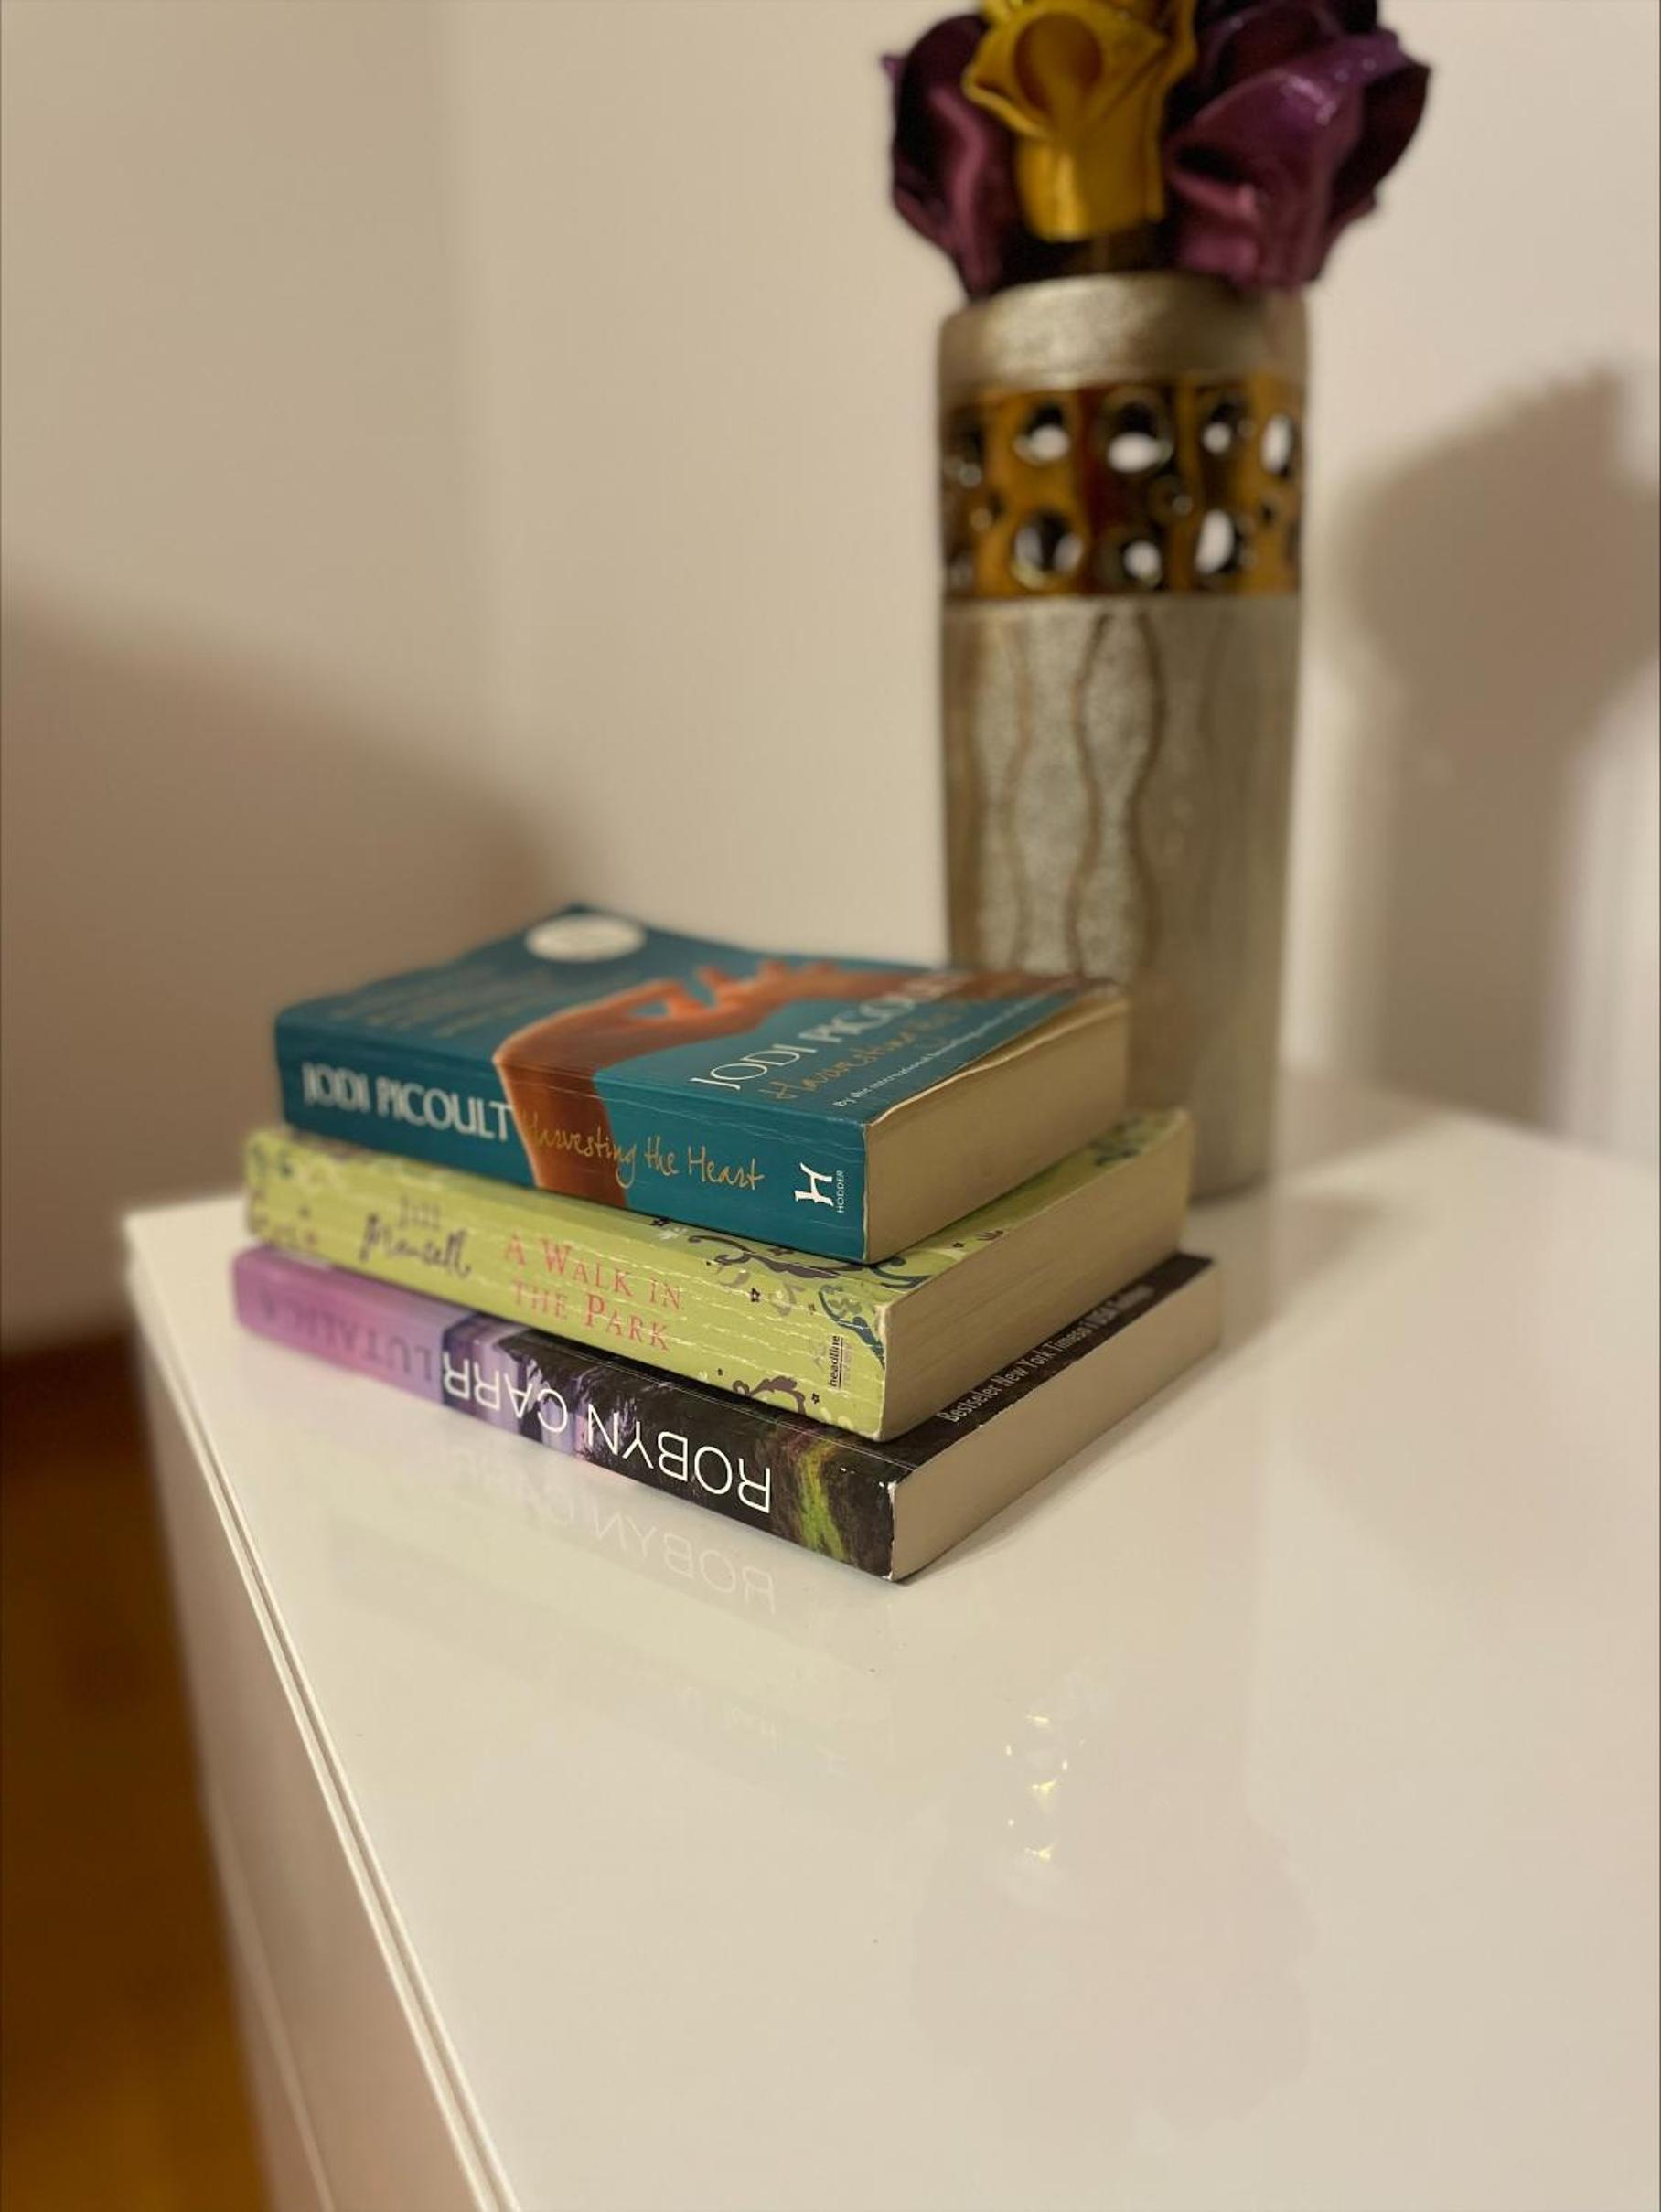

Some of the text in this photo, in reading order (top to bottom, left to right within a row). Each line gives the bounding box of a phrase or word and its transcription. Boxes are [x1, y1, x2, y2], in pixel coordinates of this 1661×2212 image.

[690, 1042, 818, 1091] JODI
[798, 971, 971, 1043] PICO
[302, 1061, 514, 1142] JODI PICOULT
[521, 1102, 766, 1190] Harvesting the Heart
[835, 1170, 846, 1214] HODDER
[504, 1230, 527, 1266] A
[441, 1350, 568, 1433] CARR
[826, 1334, 840, 1388] headline
[937, 1385, 1002, 1423] Bestseler
[991, 1363, 1029, 1389] New
[1021, 1347, 1056, 1371] York
[586, 1402, 772, 1514] ROBYN
